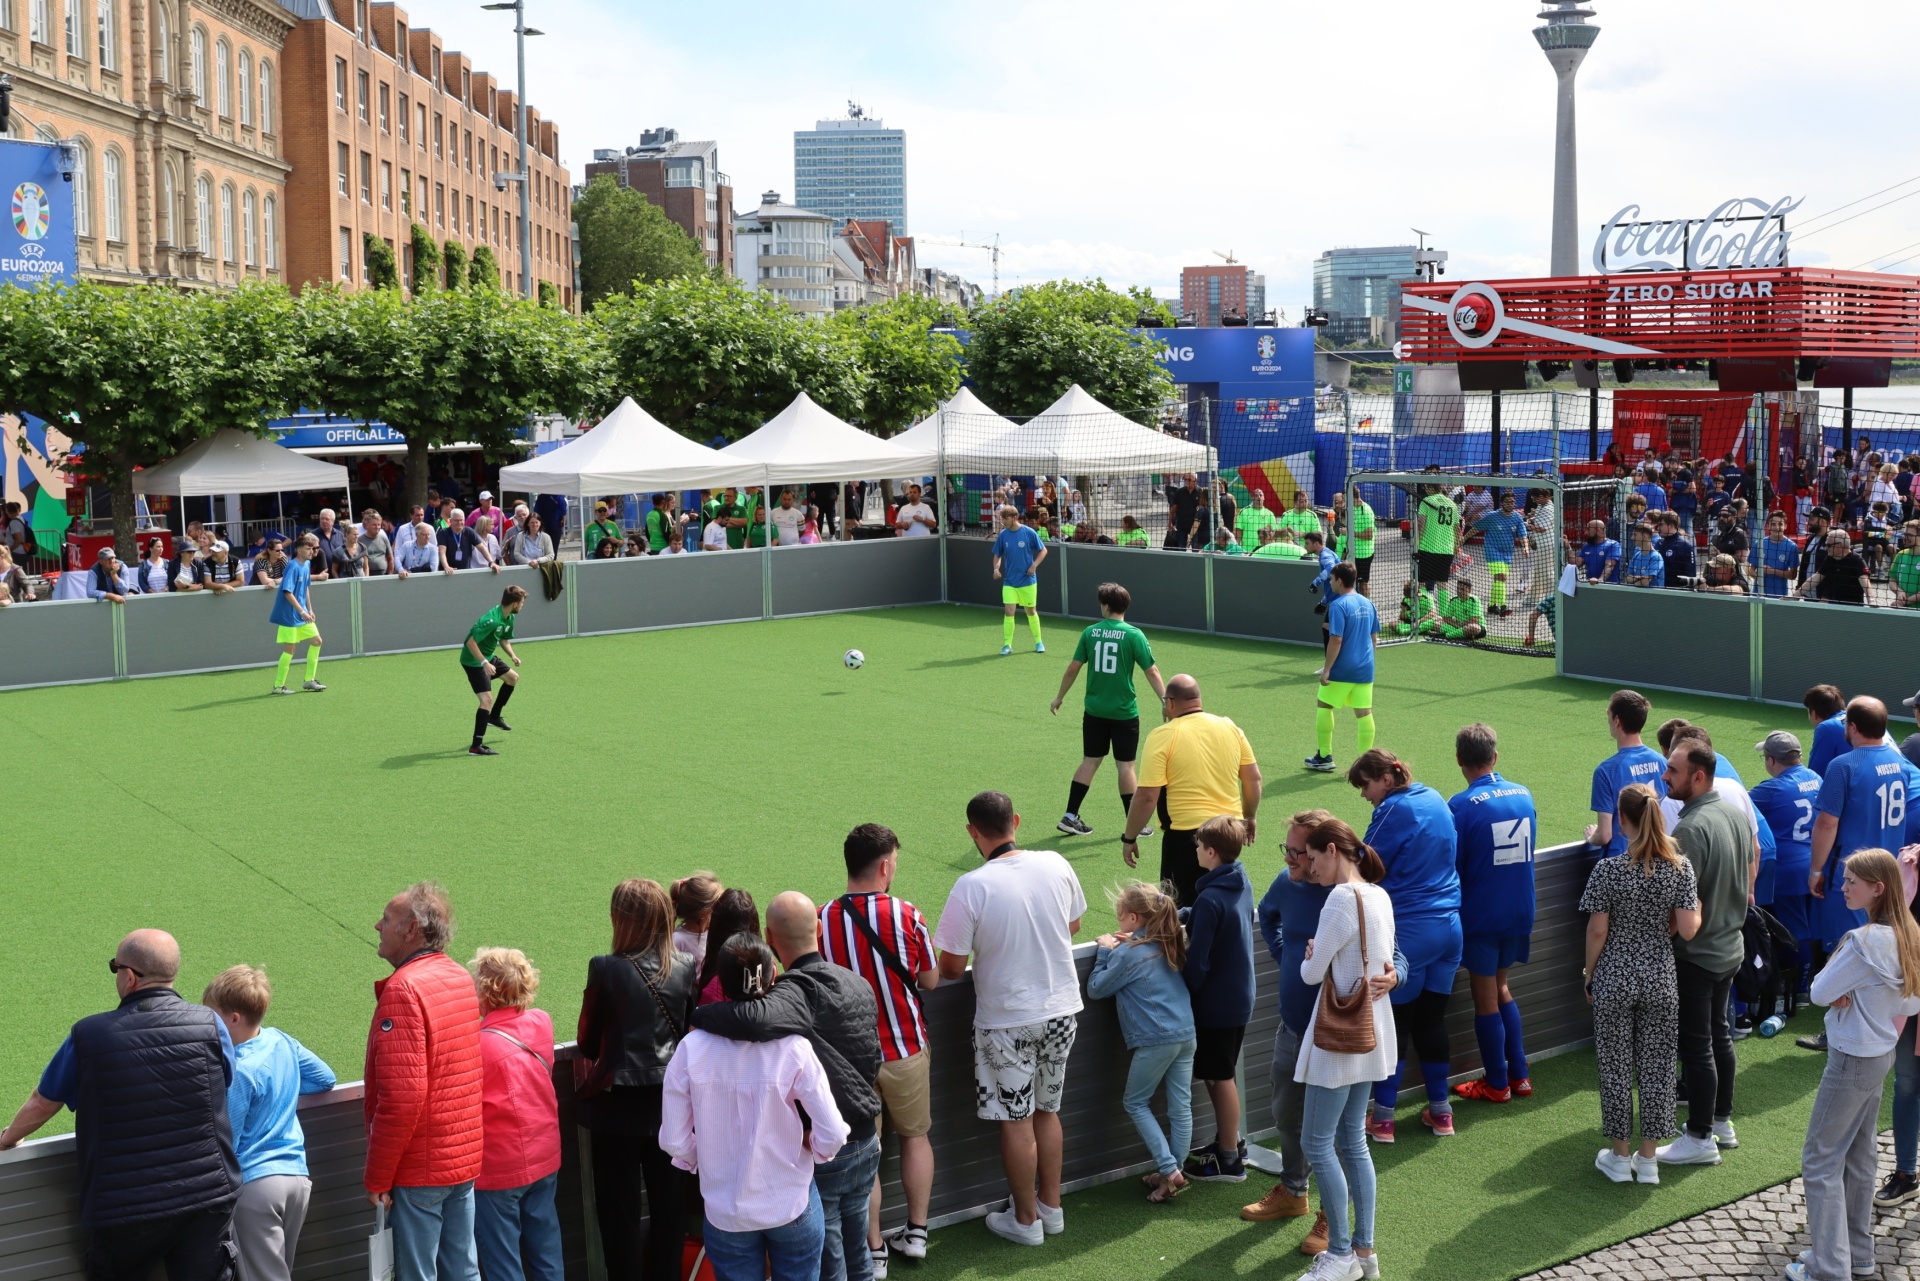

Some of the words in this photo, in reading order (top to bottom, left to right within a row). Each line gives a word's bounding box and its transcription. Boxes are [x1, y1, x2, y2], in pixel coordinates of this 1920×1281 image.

[1592, 194, 1808, 274] Coca-Cola
[20, 245, 45, 257] UEFA
[1, 258, 65, 274] EURO2024
[1606, 283, 1674, 303] ZERO
[1684, 280, 1774, 300] SUGAR
[326, 428, 386, 442] OFFICIAL
[1438, 505, 1453, 526] 63
[1091, 628, 1102, 638] SC
[1101, 629, 1127, 640] HARDT
[1094, 640, 1119, 674] 16
[1629, 761, 1660, 777] MUSSUM
[1875, 762, 1901, 777] MUSSUM
[1797, 779, 1820, 793] MUSSUM
[1470, 791, 1491, 805] TuB
[1875, 780, 1906, 830] 18
[1793, 796, 1814, 841] 2
